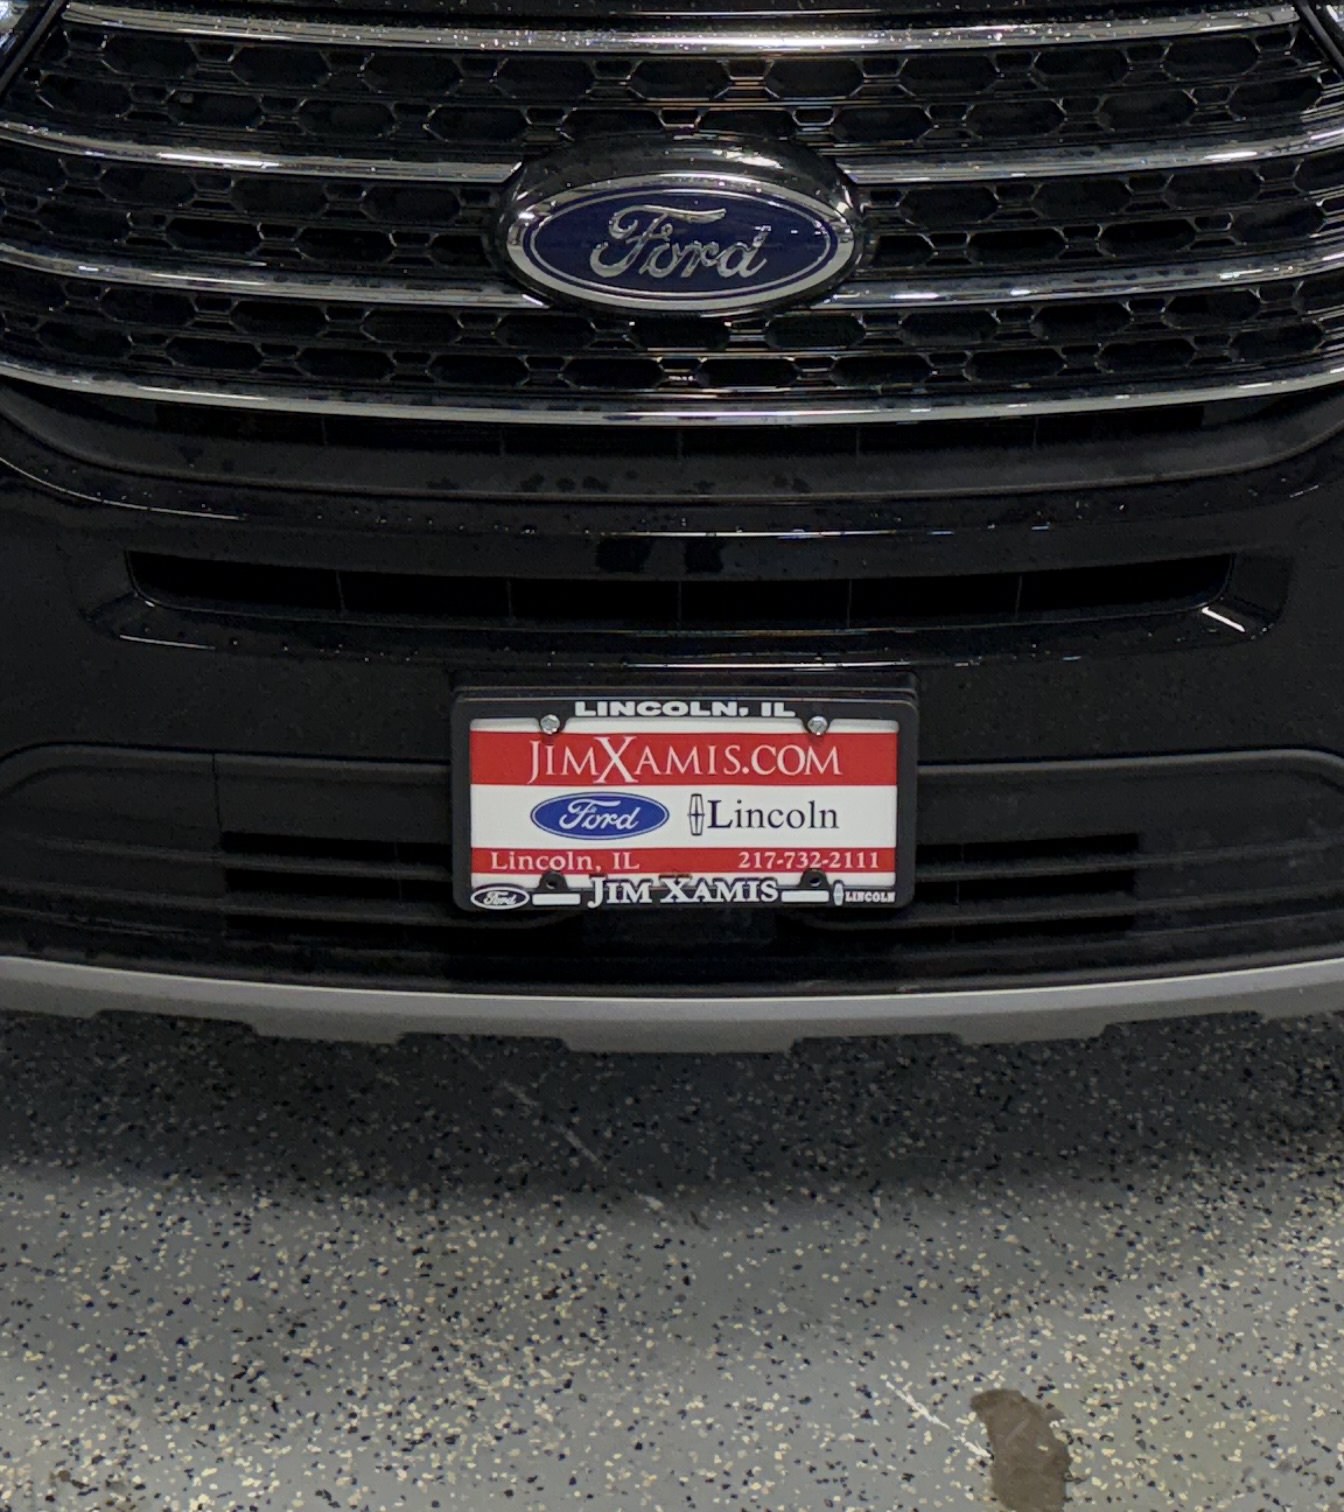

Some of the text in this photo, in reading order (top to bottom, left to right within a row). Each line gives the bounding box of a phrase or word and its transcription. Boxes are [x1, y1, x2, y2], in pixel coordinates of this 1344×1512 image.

[590, 204, 768, 278] Ford
[574, 701, 795, 718] LINCOLN, IL
[559, 799, 639, 831] Ford
[708, 800, 838, 828] Lincoln
[490, 851, 639, 873] Lincoln, IL
[739, 852, 878, 869] 217-732-2111
[588, 877, 779, 908] JIM XAMIS
[845, 891, 896, 903] LINCOLN
